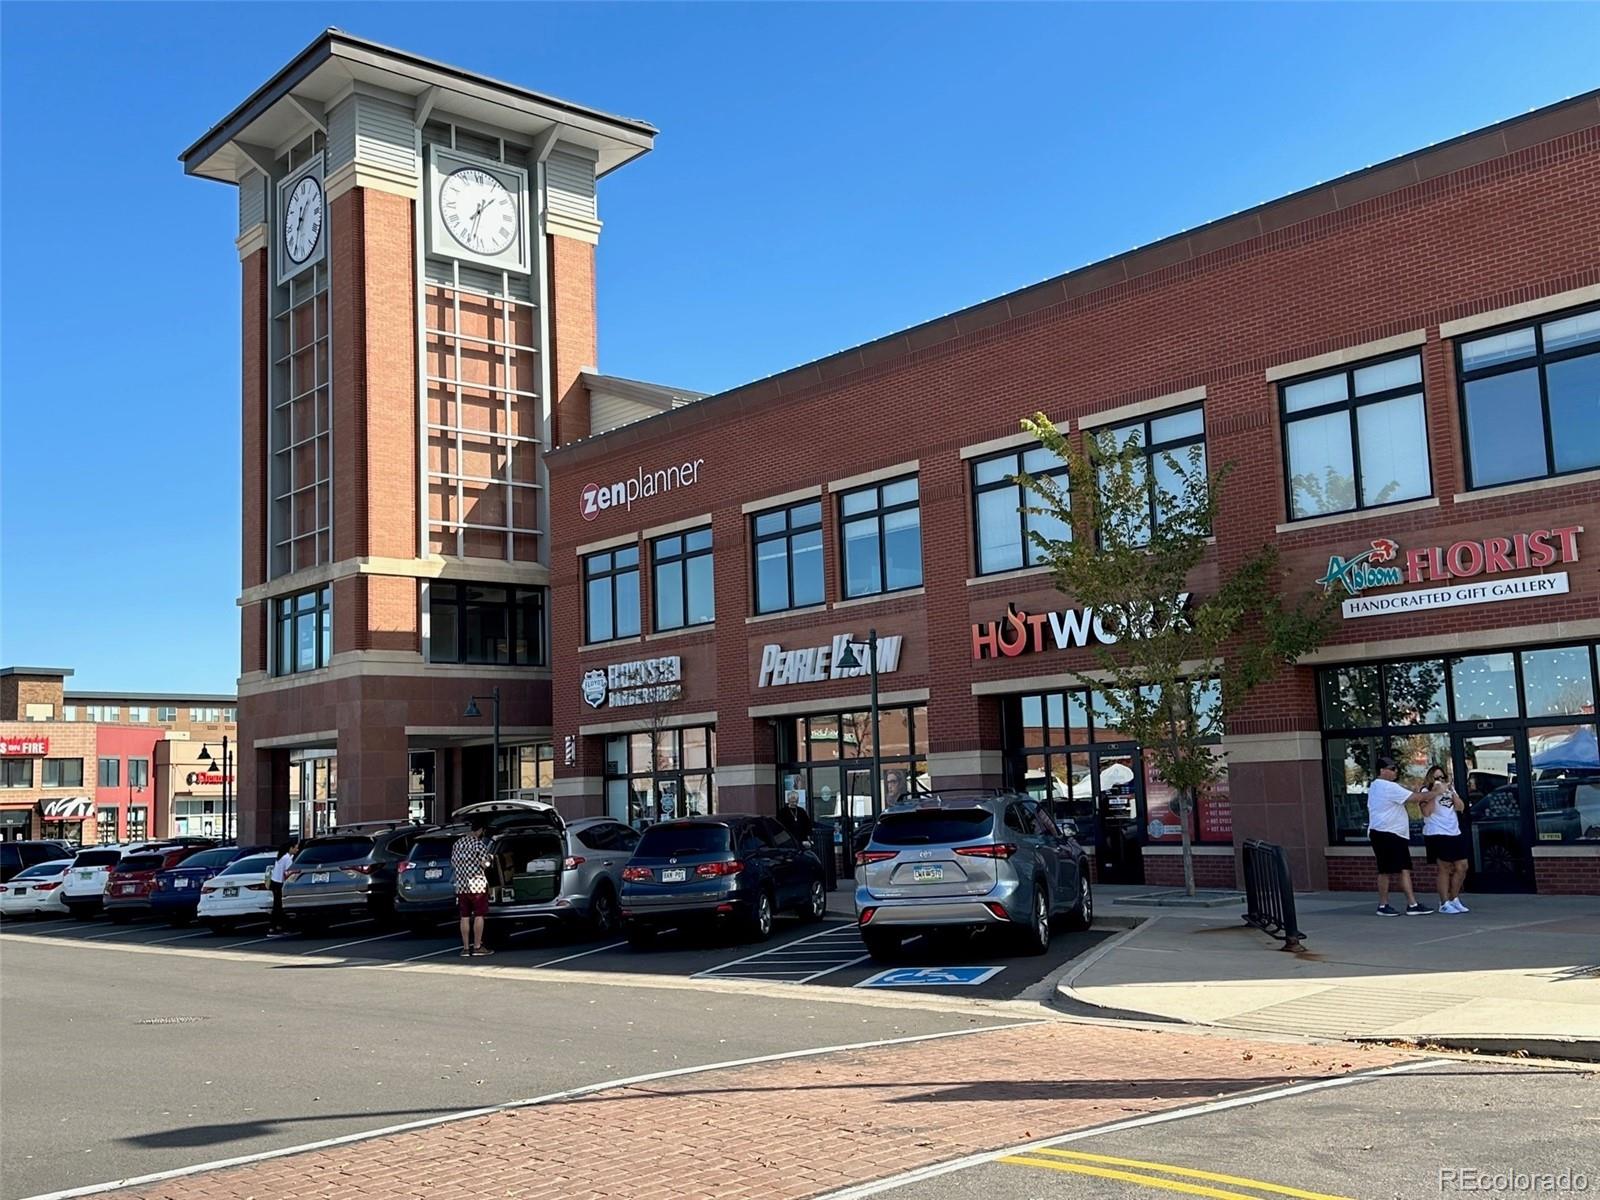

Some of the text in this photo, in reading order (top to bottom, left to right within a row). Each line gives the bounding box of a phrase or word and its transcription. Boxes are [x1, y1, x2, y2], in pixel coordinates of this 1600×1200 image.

[1406, 526, 1584, 583] FLORIST
[1350, 578, 1557, 613] HANDCRAFTED GIFT GALLERY
[758, 644, 831, 687] PEARLE
[22, 742, 45, 754] FIRE
